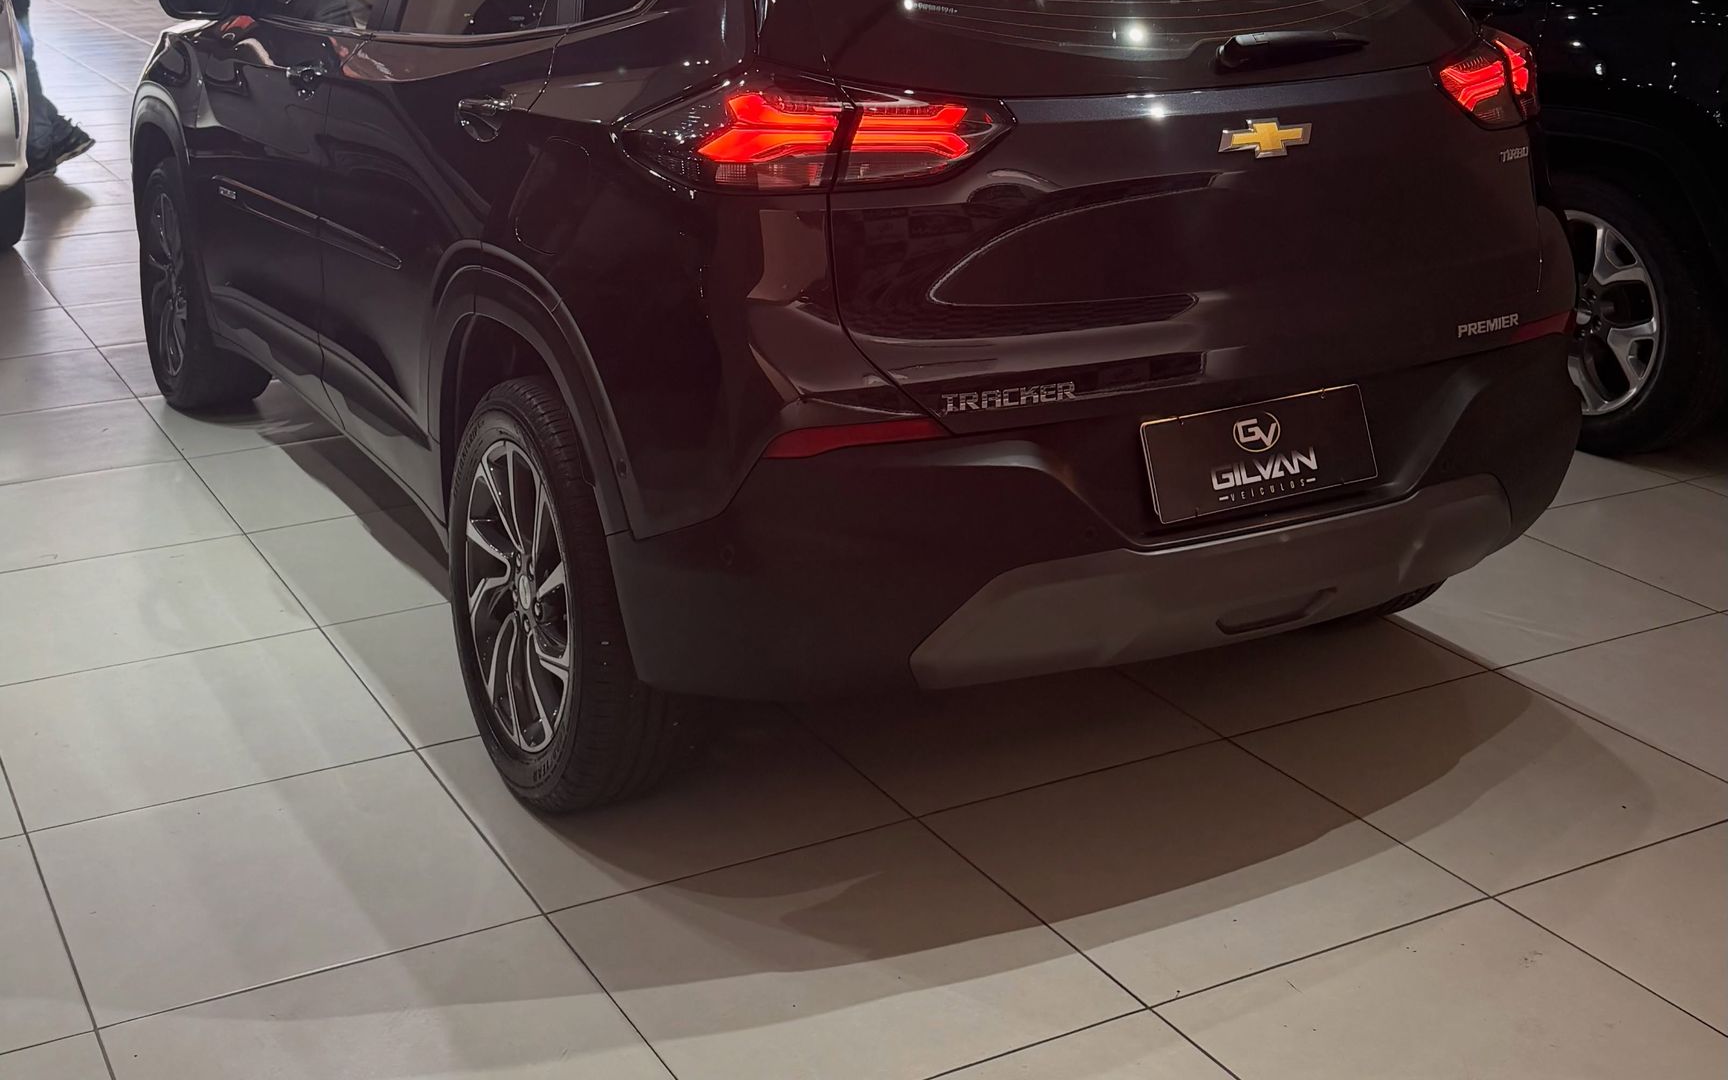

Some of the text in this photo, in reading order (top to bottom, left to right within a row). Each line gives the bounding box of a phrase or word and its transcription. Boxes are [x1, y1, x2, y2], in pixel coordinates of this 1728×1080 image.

[1500, 146, 1529, 163] TURBO
[1457, 313, 1519, 338] PREMIER
[942, 381, 1077, 412] TRACKER
[1236, 418, 1277, 447] GV
[1211, 447, 1318, 491] GILVAN
